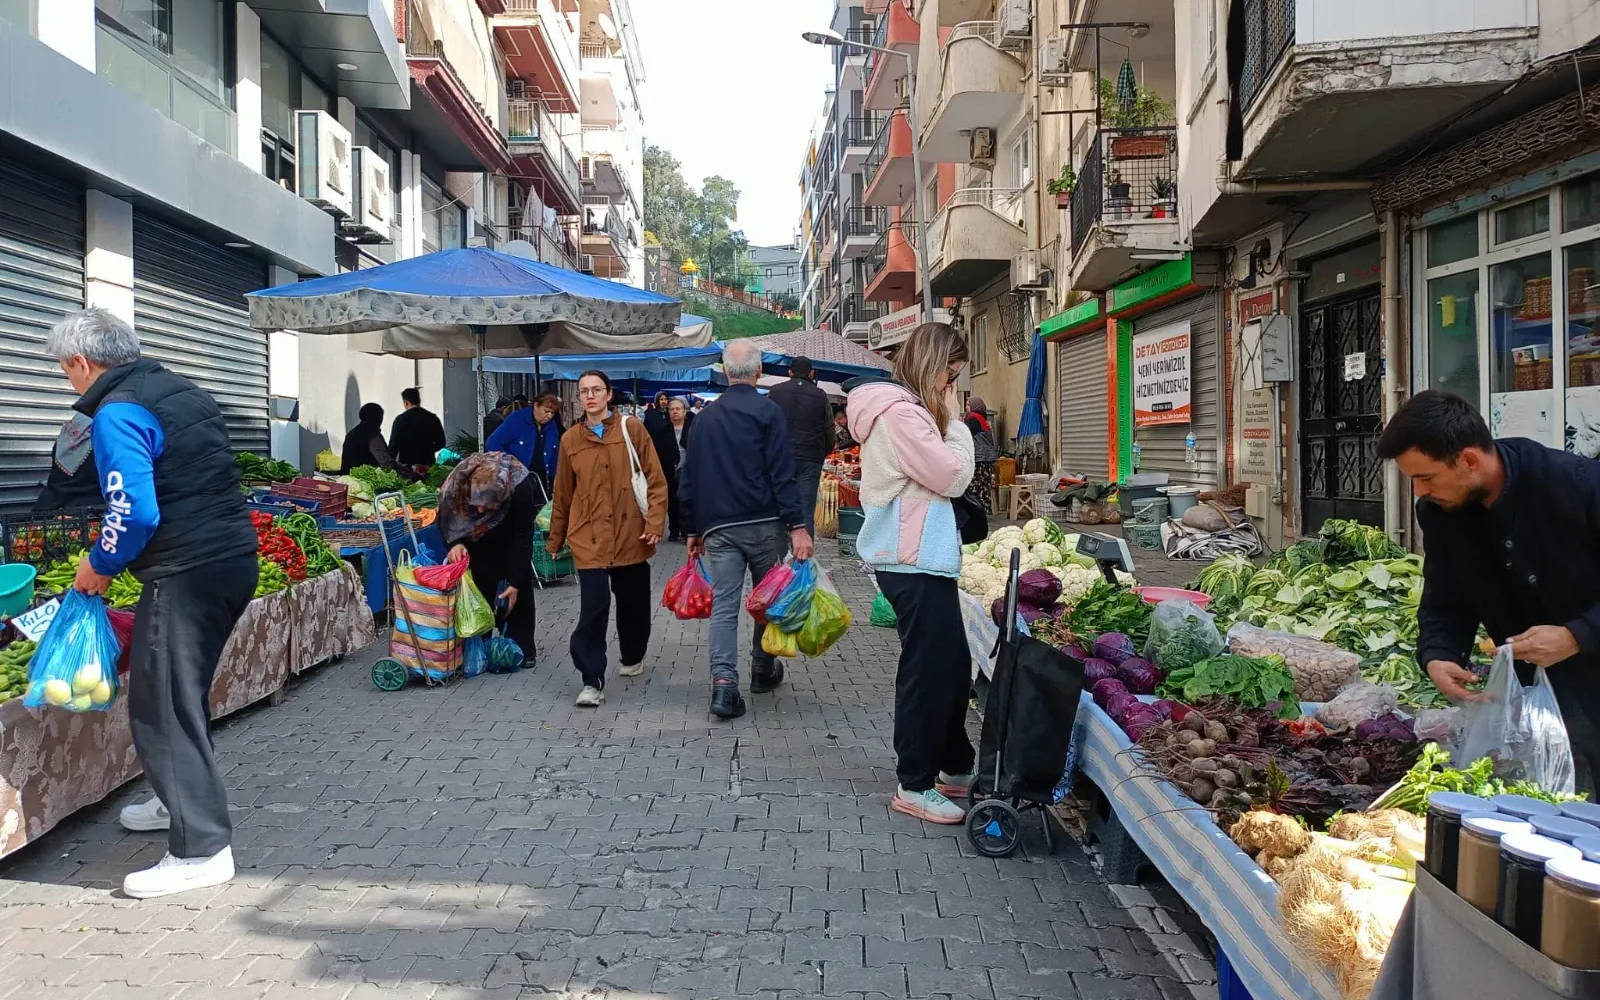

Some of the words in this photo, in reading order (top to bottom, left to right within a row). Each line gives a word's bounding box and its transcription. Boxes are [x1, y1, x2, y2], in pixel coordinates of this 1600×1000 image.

[1138, 360, 1152, 378] YENİ
[1152, 355, 1186, 376] YERİMİZDE
[1135, 375, 1189, 398] HİZMETİNİZDEYİZ
[101, 470, 132, 554] adidas
